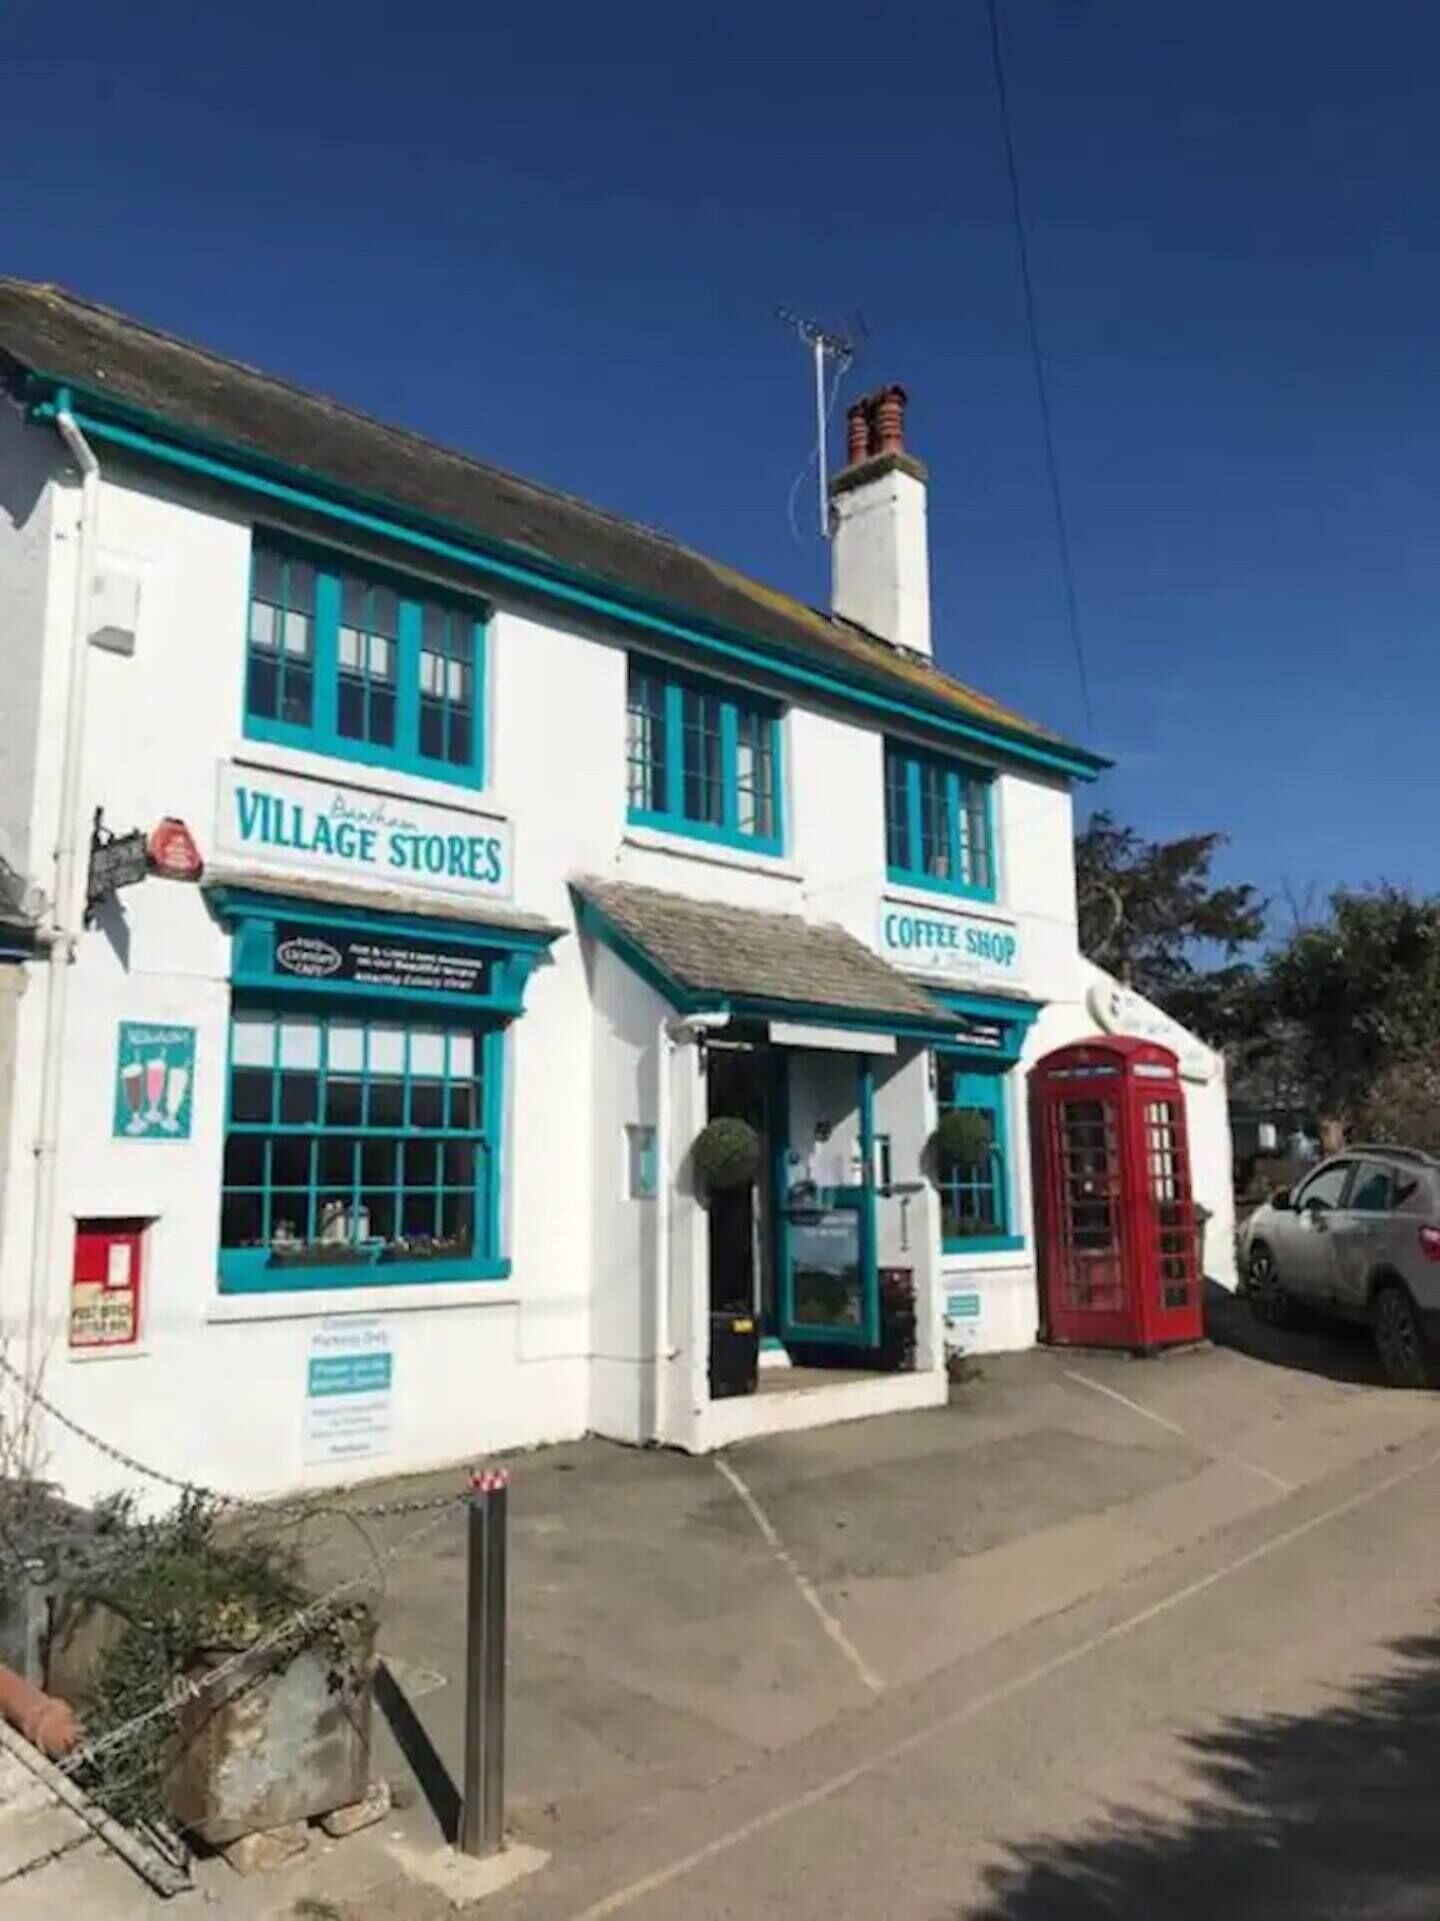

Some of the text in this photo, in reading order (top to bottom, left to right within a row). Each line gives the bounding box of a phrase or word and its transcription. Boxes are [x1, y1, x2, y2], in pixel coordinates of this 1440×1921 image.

[235, 786, 377, 862] VILLAGE
[388, 831, 503, 884] STORES
[885, 913, 960, 948] COFFEE
[965, 927, 1017, 967] SHOP
